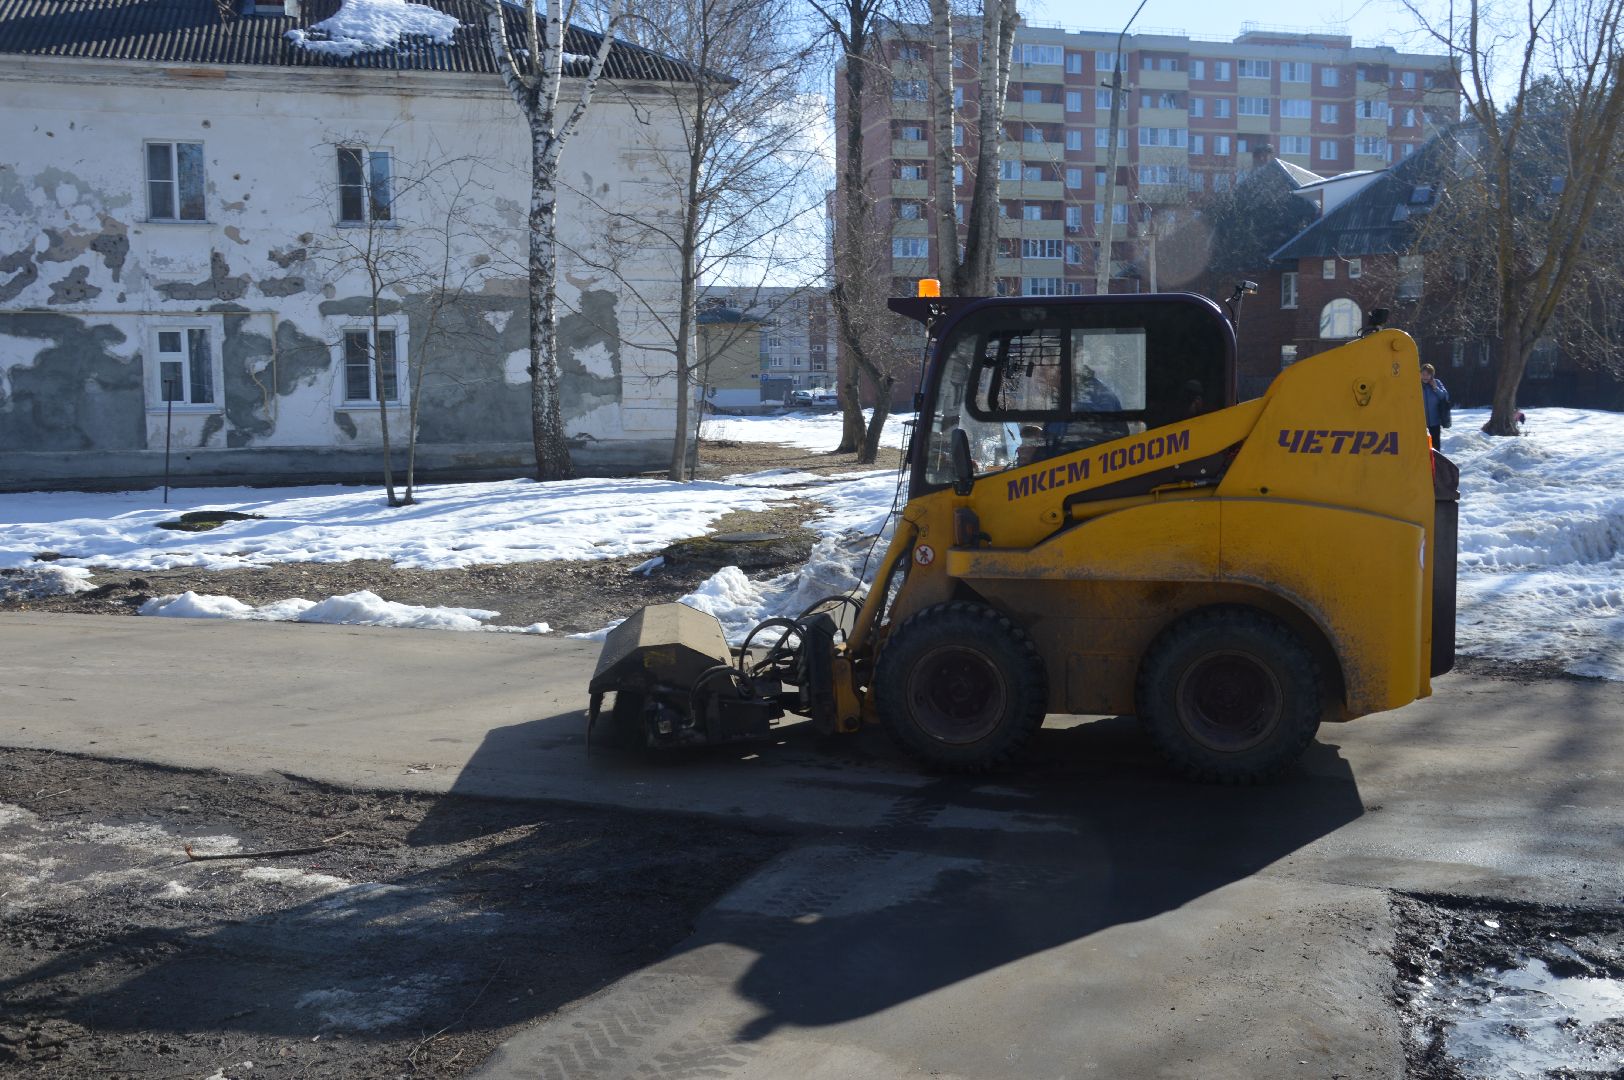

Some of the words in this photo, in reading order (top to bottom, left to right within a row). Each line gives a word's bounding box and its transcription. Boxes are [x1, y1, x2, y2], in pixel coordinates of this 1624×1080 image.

[1007, 458, 1090, 501] МКСМ
[1098, 429, 1190, 474] 1000М
[1278, 429, 1399, 455] ЧЕТРА
